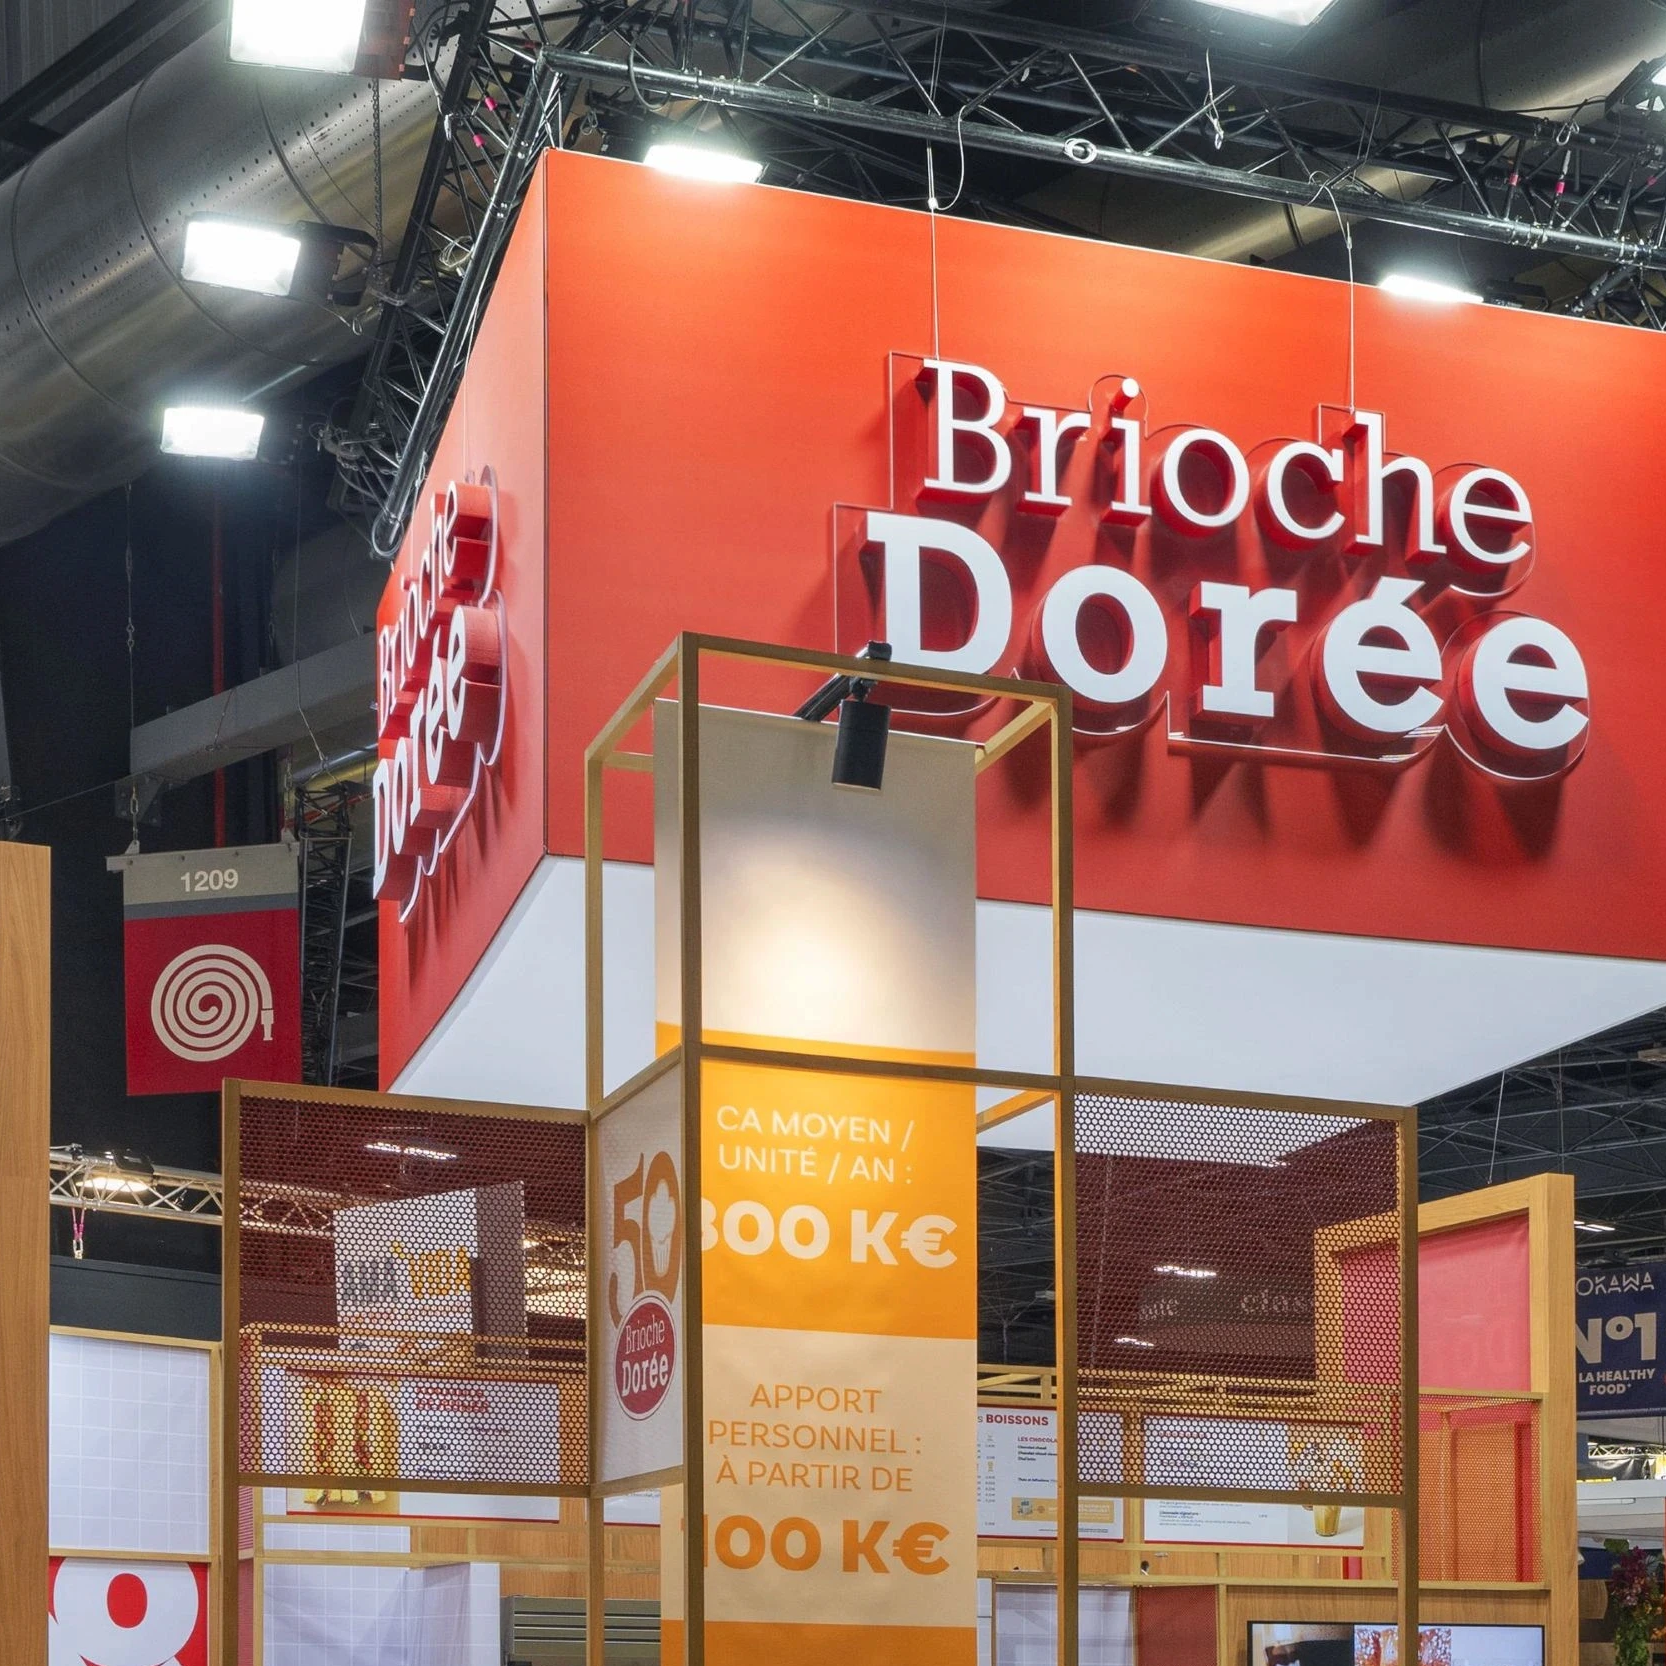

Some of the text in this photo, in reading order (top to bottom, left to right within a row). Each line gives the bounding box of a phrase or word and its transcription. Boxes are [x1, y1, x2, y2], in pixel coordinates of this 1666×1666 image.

[922, 356, 1533, 565] Brioche
[378, 480, 459, 738] Brioche
[865, 510, 1591, 750] Dorée
[373, 604, 467, 900] Dorée
[180, 868, 239, 893] 1209
[717, 1105, 915, 1152] CA MOYEN /
[718, 1144, 818, 1178] UNITÉ
[827, 1152, 841, 1185] /
[848, 1155, 895, 1184] AN
[849, 1209, 958, 1270] K€
[1576, 1271, 1655, 1297] OKAWA
[625, 1313, 665, 1355] Brioche
[621, 1350, 669, 1398] Dorée
[1578, 1368, 1656, 1383] LA HEALTHY
[749, 1383, 883, 1414] APPORT
[708, 1420, 907, 1455] PERSONNEL
[985, 1414, 1049, 1426] BOISSONS
[715, 1454, 914, 1493] À PARTIR DE
[842, 1518, 951, 1576] K€
